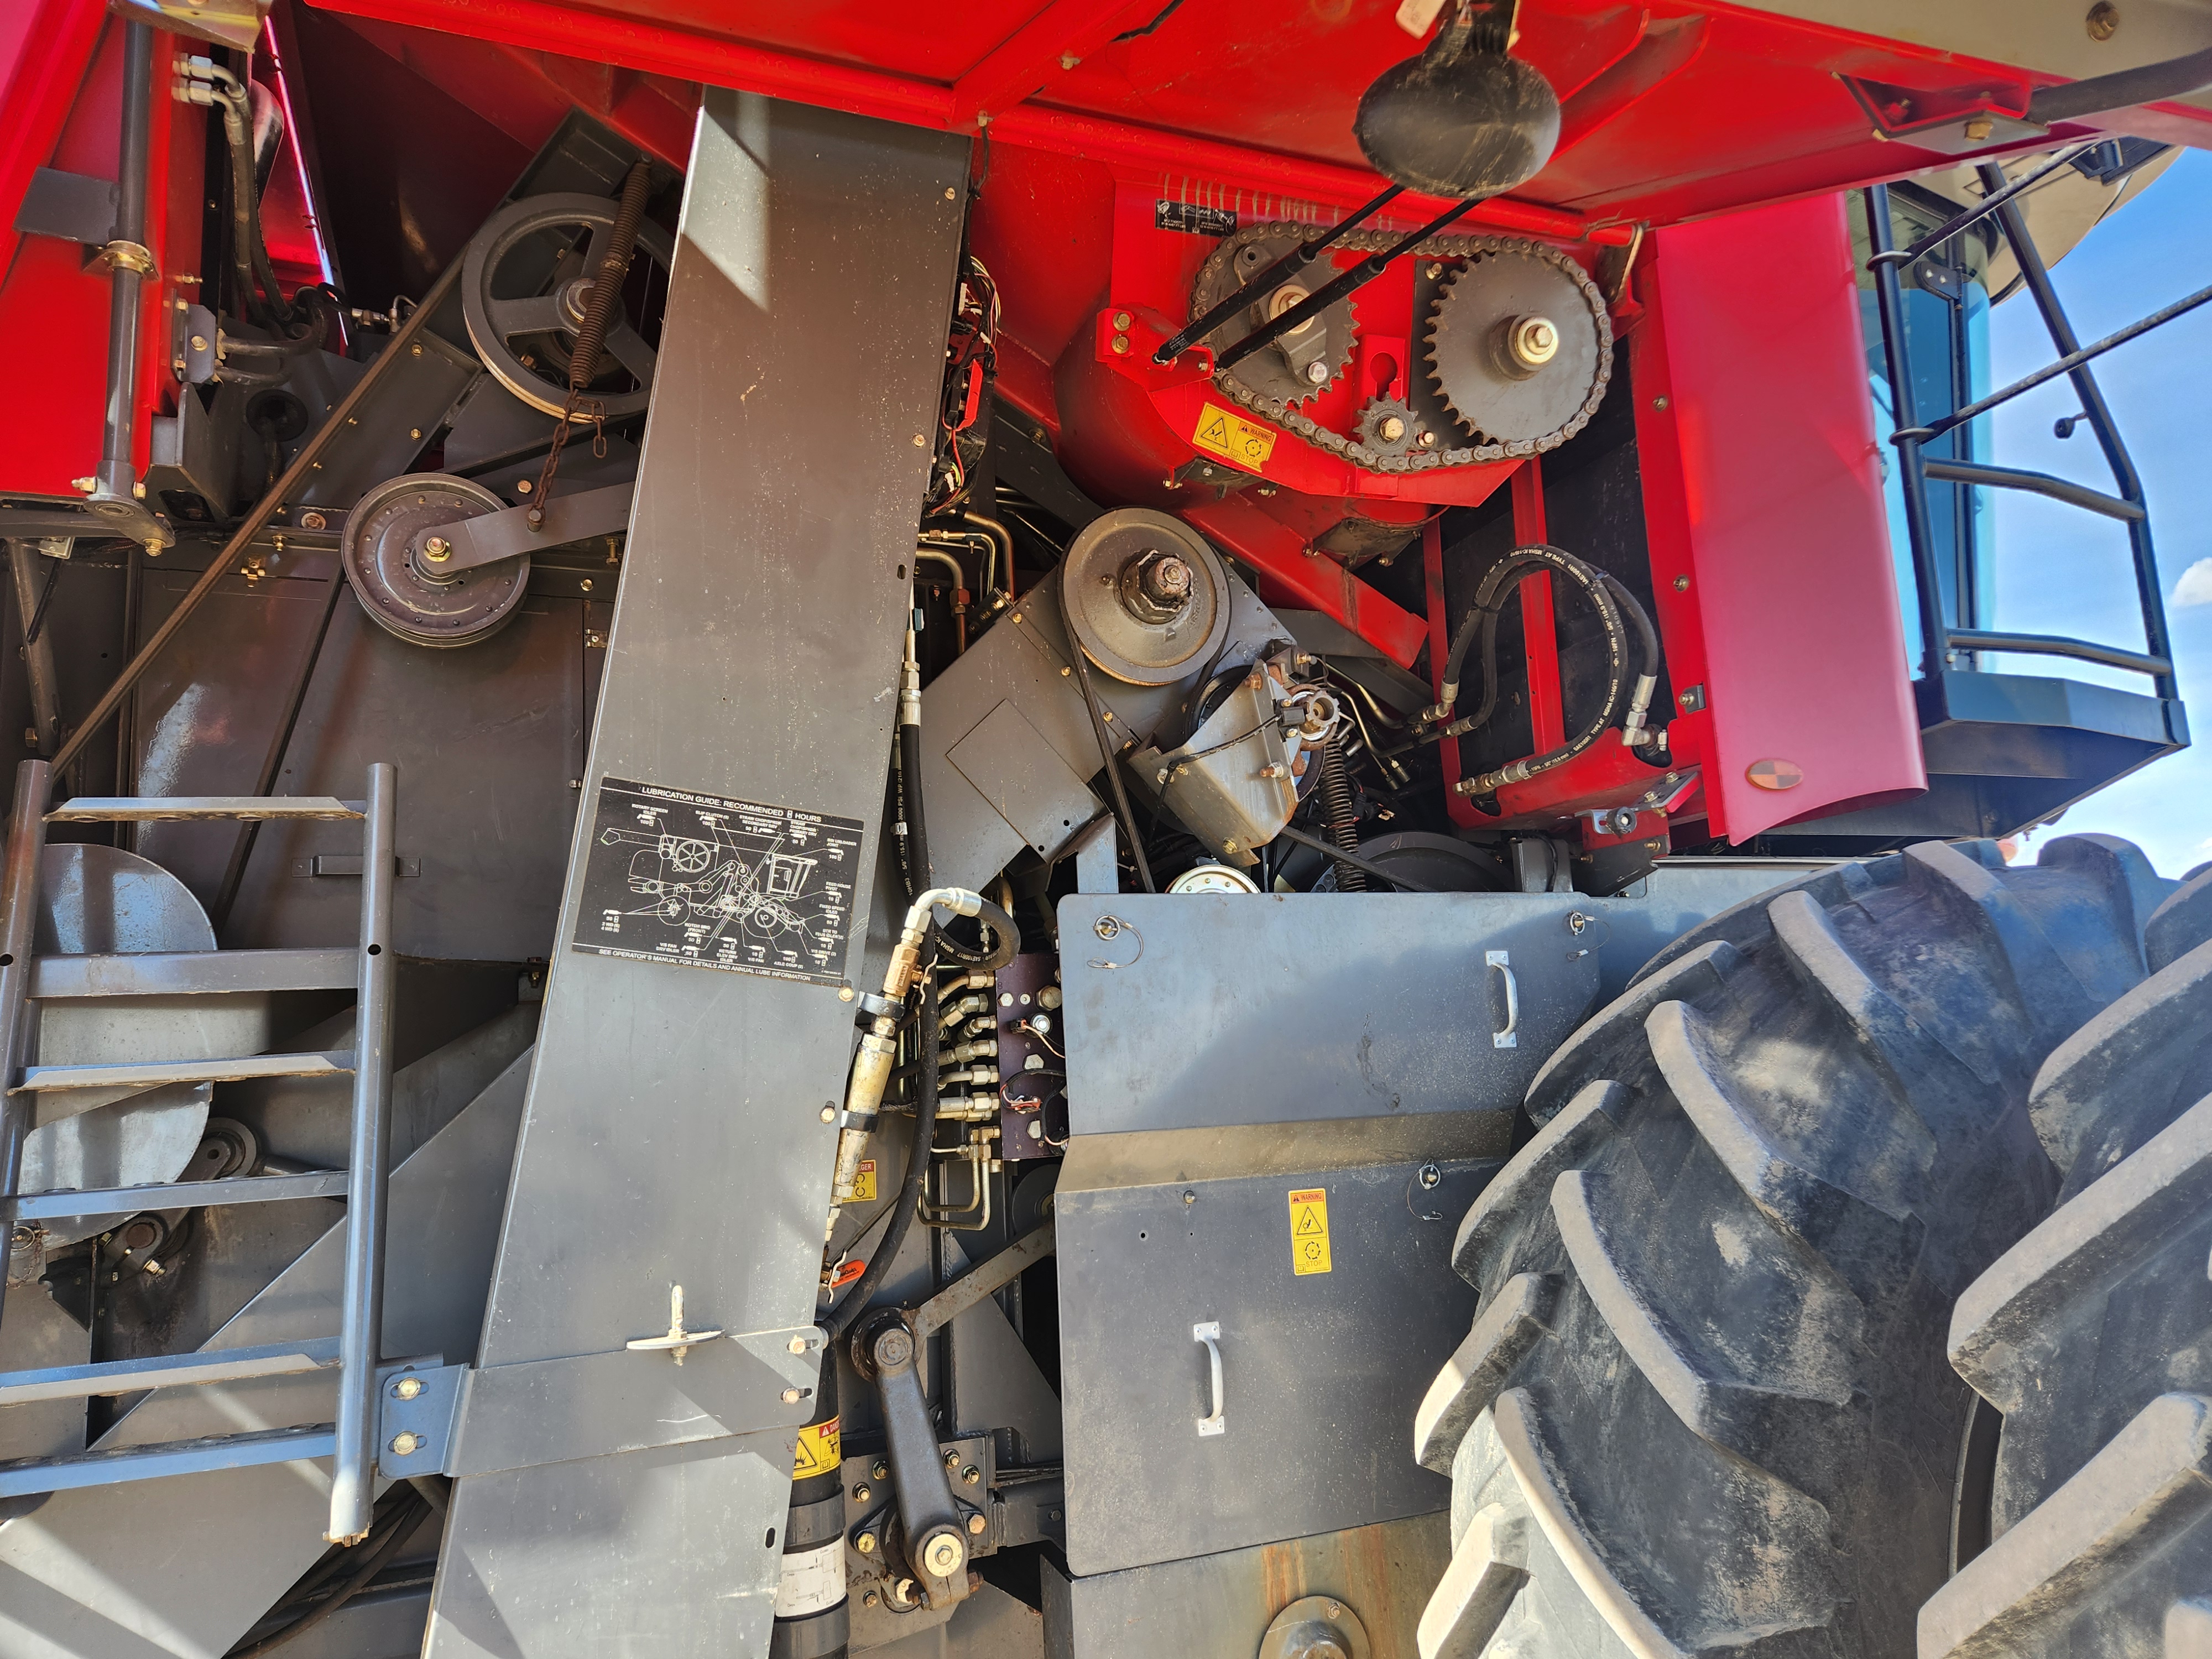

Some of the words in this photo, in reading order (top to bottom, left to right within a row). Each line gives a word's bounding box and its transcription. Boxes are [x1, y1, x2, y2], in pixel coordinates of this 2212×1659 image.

[1250, 427, 1271, 442] WARNING
[1241, 454, 1258, 465] STOP
[1552, 554, 1565, 565] TYPE
[1591, 722, 1601, 735] TYPE
[1599, 717, 1605, 726] AT
[1603, 702, 1613, 716] MSHA
[897, 784, 903, 794] WP
[641, 786, 693, 801] LUBRICATION
[695, 795, 722, 806] GUIDE:
[723, 800, 784, 816] RECOMMENDED
[795, 812, 821, 822] HOURS
[940, 941, 955, 953] MSHA
[957, 952, 981, 962] SAE100R17
[612, 950, 651, 961] OPERATOR'S
[692, 961, 717, 969] DETAILS
[771, 971, 811, 981] INFORMATION
